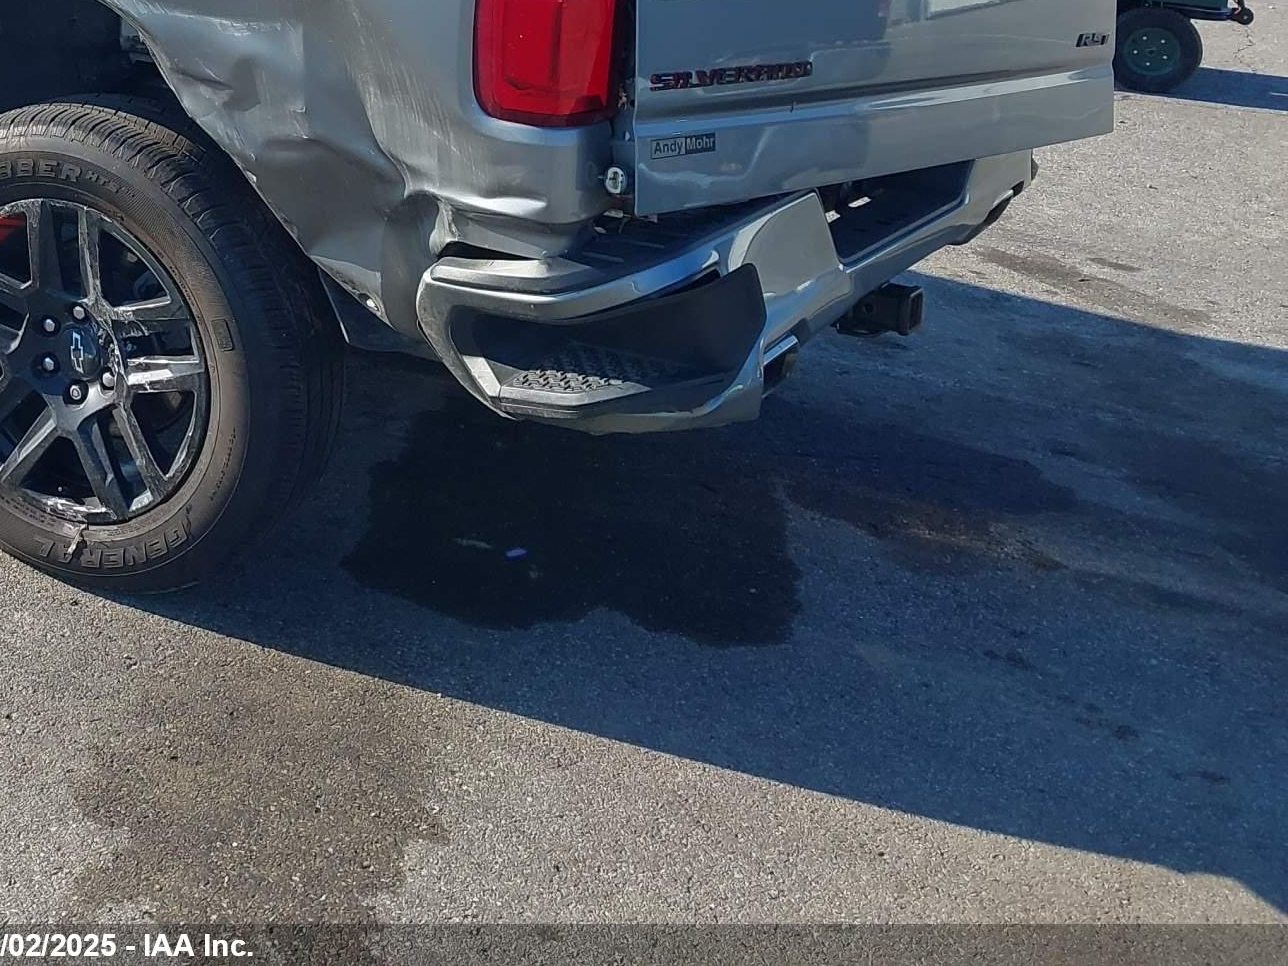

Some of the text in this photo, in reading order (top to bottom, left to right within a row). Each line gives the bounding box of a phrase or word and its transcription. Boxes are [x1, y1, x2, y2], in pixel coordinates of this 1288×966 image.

[650, 60, 813, 91] SILVERADO
[654, 136, 714, 155] Andy Mohr
[34, 521, 188, 569] GENERAL
